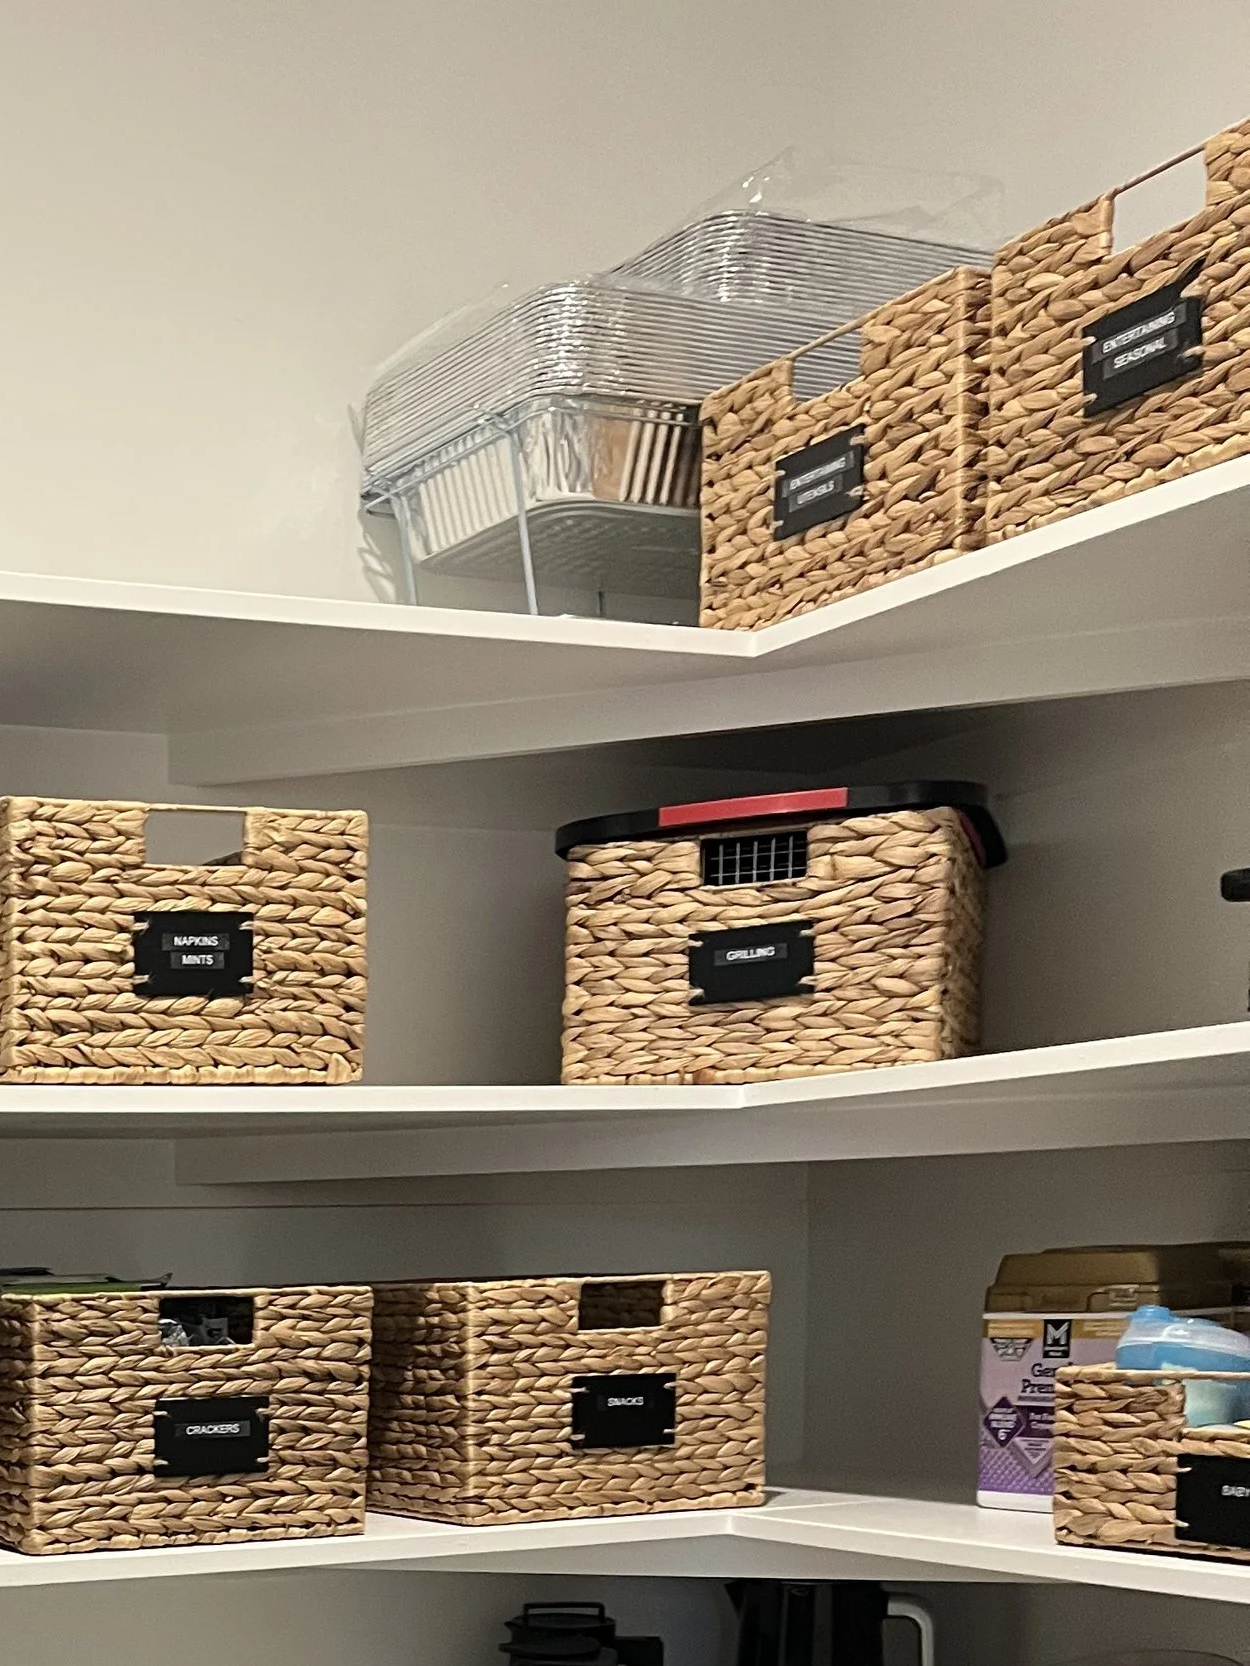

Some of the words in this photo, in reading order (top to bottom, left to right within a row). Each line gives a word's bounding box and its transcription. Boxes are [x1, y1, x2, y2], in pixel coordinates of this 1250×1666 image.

[1101, 311, 1176, 355] ENTERTAINING
[1112, 336, 1168, 370] SEASONAL
[173, 935, 219, 947] NAPKINS
[726, 945, 777, 961] GRILLING
[181, 954, 214, 966] MINTS
[607, 1396, 644, 1407] SNACKS
[185, 1423, 240, 1435] CRACKERS
